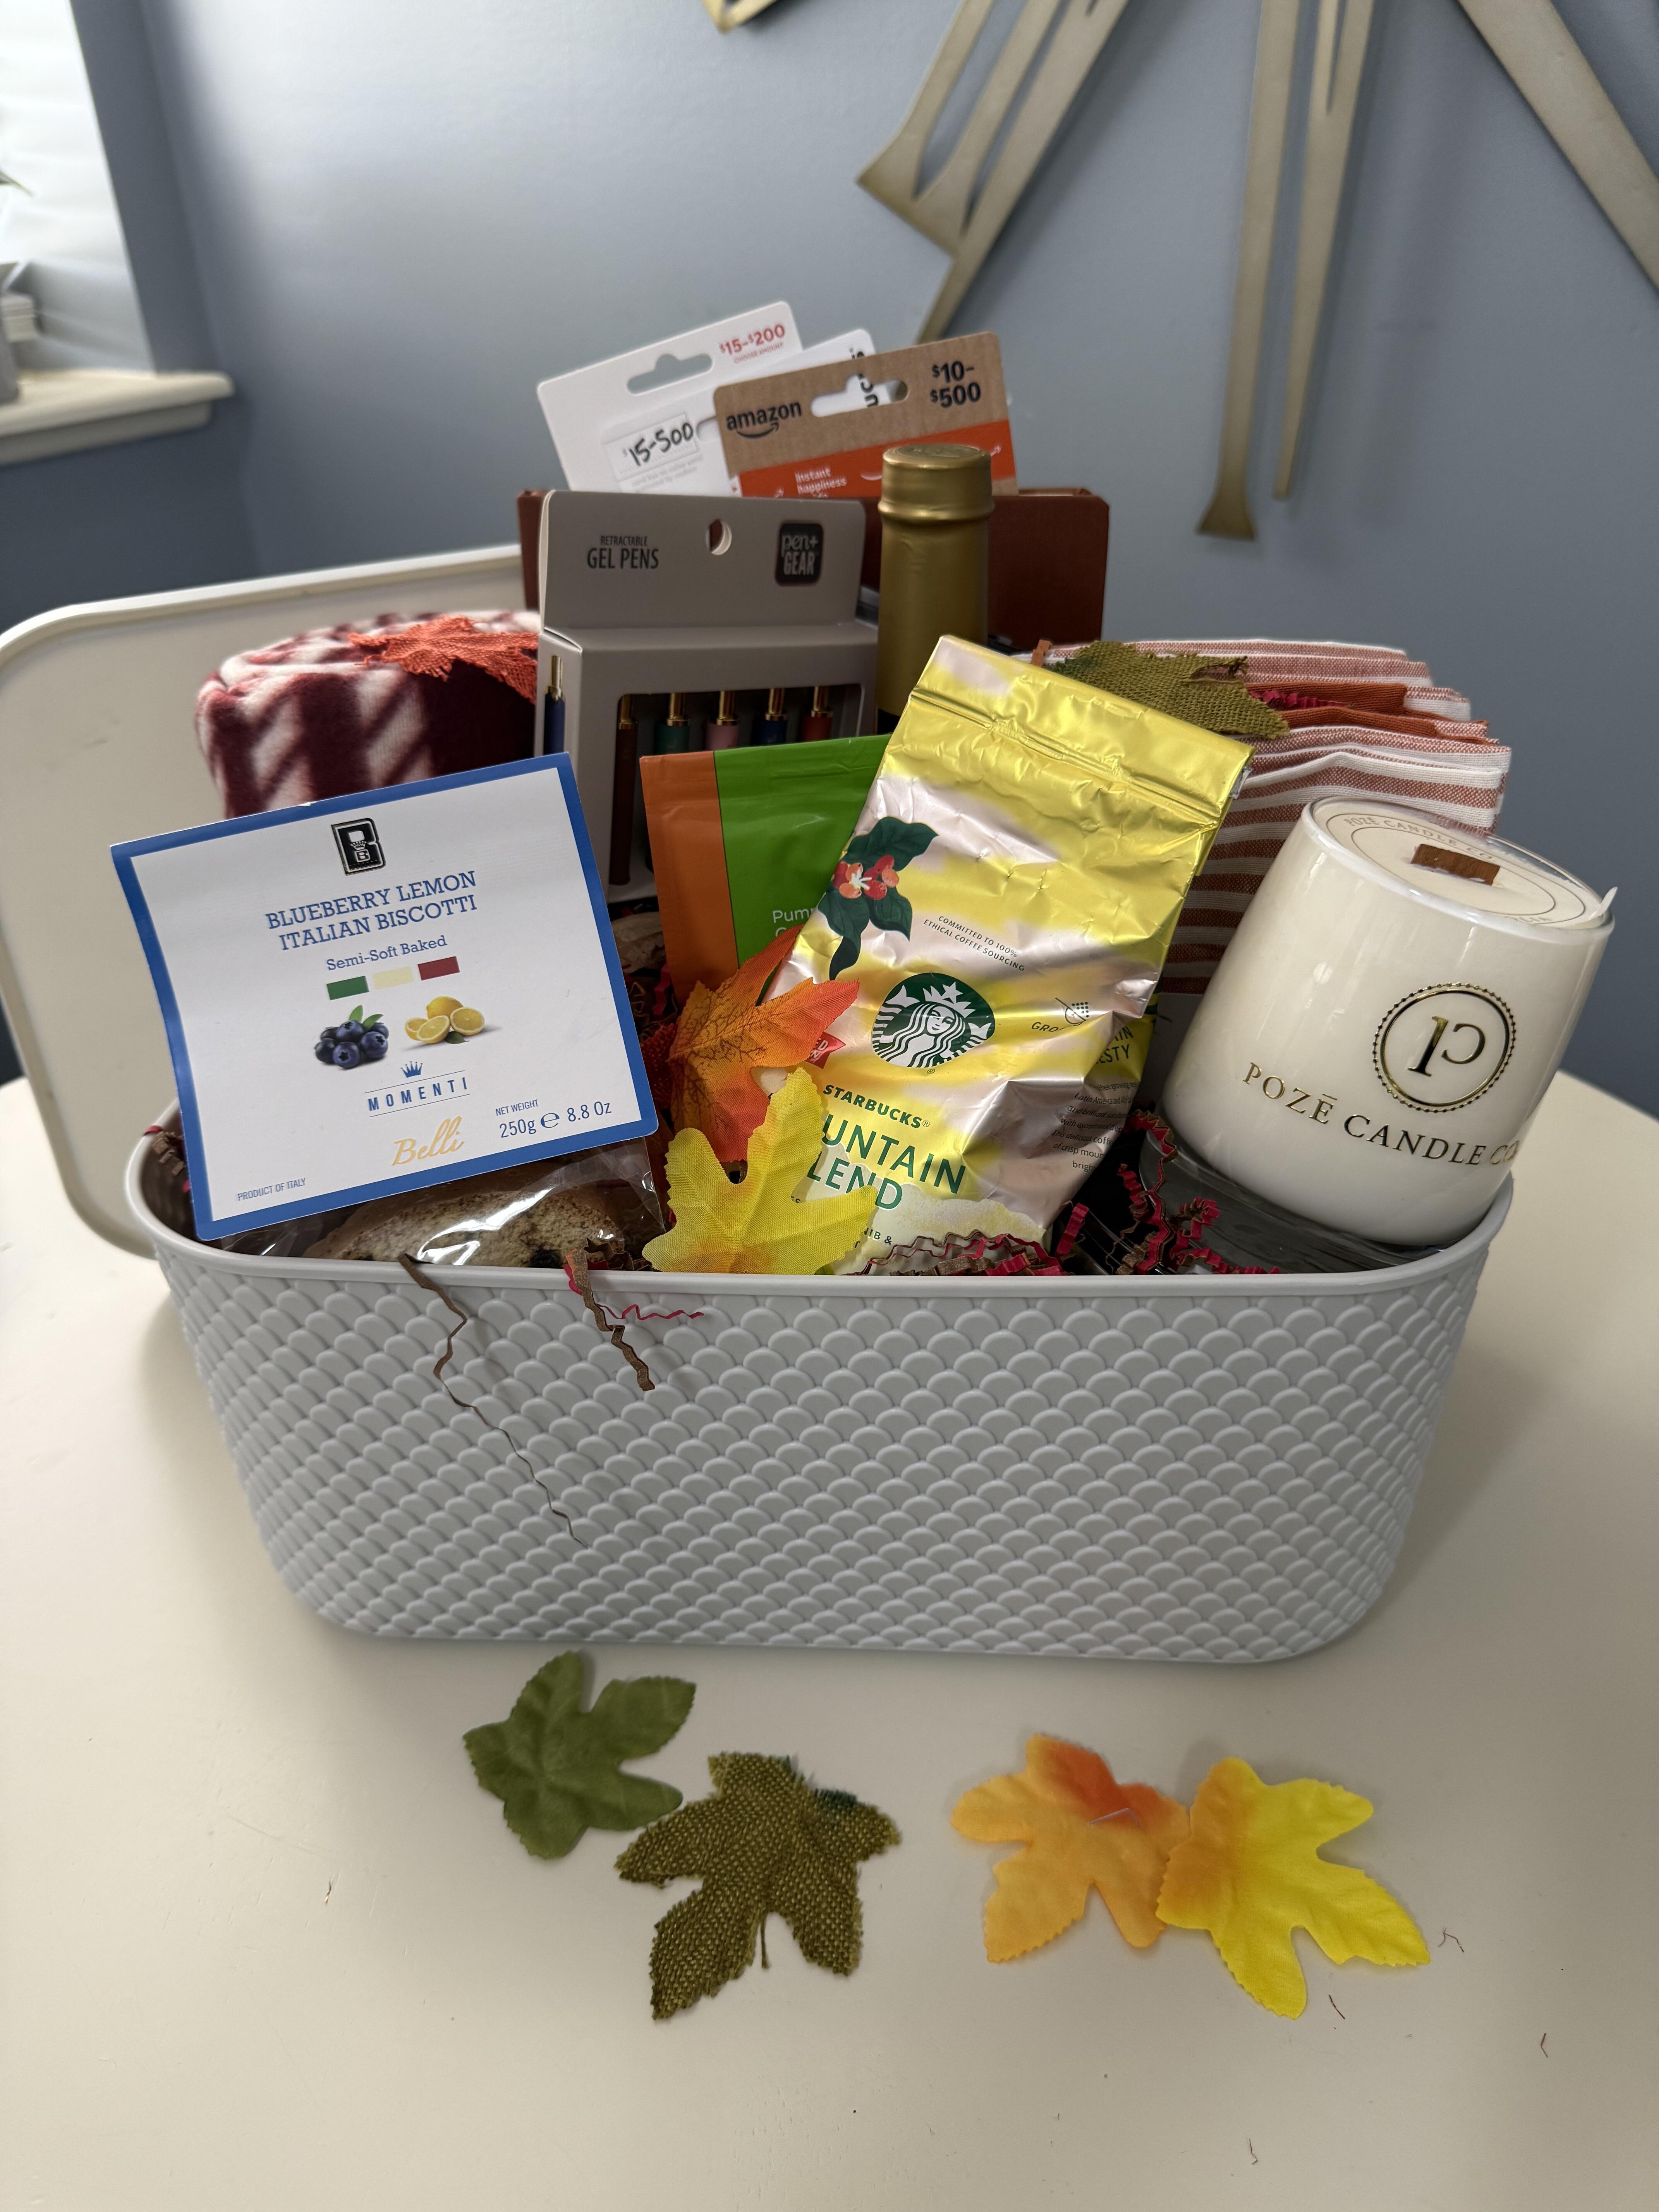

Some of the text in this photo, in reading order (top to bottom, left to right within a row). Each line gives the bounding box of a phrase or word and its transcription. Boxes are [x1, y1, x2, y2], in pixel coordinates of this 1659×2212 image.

[930, 382, 981, 408] $500
[726, 402, 802, 431] amazon
[600, 535, 648, 546] RETRACTABLE
[587, 547, 659, 569] GEL PENS
[784, 551, 816, 575] GEAR
[1384, 820, 1457, 846] CANDLE
[266, 871, 476, 929] BLUEBERRY LEMON
[279, 895, 477, 950] ITALIAN BISCOTTI
[939, 916, 1017, 958] COMMITTED TO 100%
[326, 935, 448, 970] Semi-Soft Baked
[924, 919, 1025, 971] ETHICAL COFFEE SOURCING
[368, 1077, 467, 1111] MOMENTI
[495, 1099, 538, 1116] NET WEIGHT
[1073, 1092, 1092, 1103] Latin
[499, 1119, 537, 1138] 250g
[567, 1104, 590, 1122] 8.8
[594, 1101, 612, 1116] Oz
[1061, 1118, 1076, 1127] with
[1109, 1123, 1123, 1133] dep
[392, 1116, 465, 1166] Belli
[1051, 1129, 1065, 1137] This
[1093, 1137, 1114, 1146] coffe
[1061, 1145, 1078, 1155] crisp
[1080, 1149, 1104, 1159] moun
[1344, 1114, 1486, 1165] CANDLE
[821, 1114, 966, 1194] UNTAIN
[237, 1178, 306, 1201] PRODUCT OF ITALY
[807, 1151, 903, 1210] LEND
